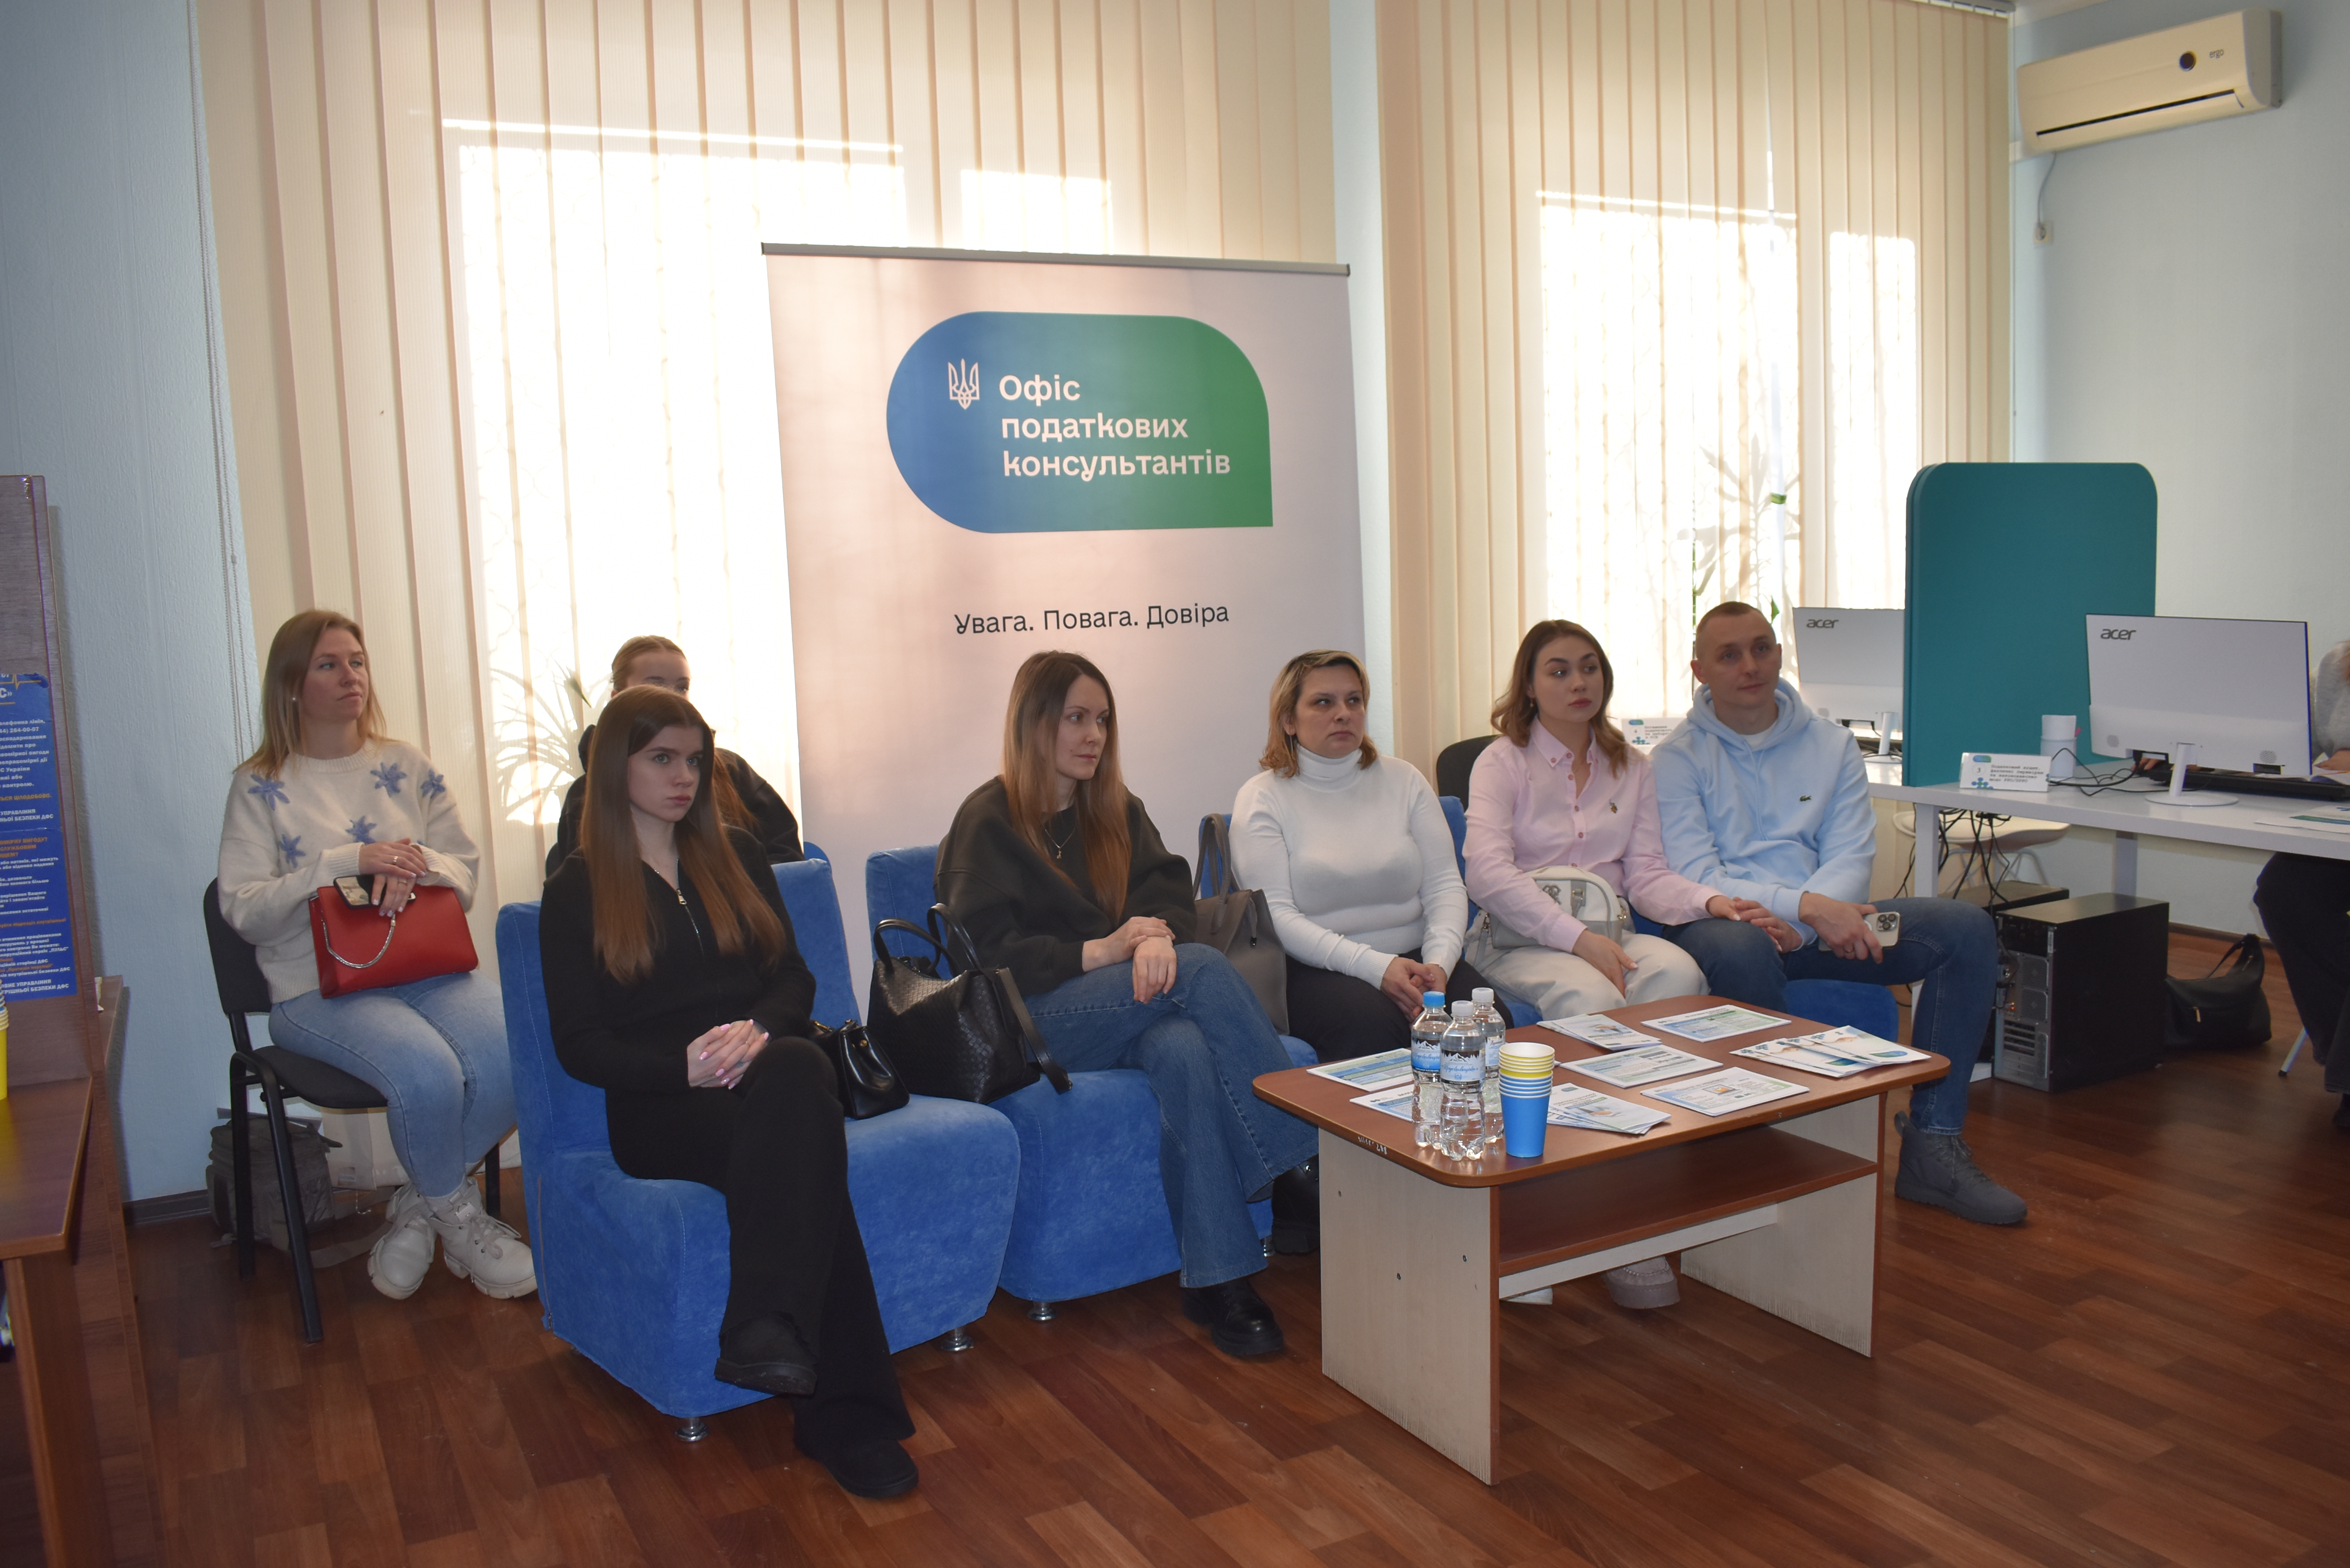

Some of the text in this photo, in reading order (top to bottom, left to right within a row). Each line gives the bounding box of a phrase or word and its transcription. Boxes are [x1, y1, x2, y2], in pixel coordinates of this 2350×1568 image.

[2209, 49, 2224, 59] ergo
[999, 374, 1080, 406] Офіс
[1001, 412, 1188, 442] податкових
[1004, 449, 1230, 481] консультантів
[954, 602, 1229, 635] Увага. Повага. Довіра
[1807, 619, 1839, 628] acer
[2101, 629, 2136, 640] acer
